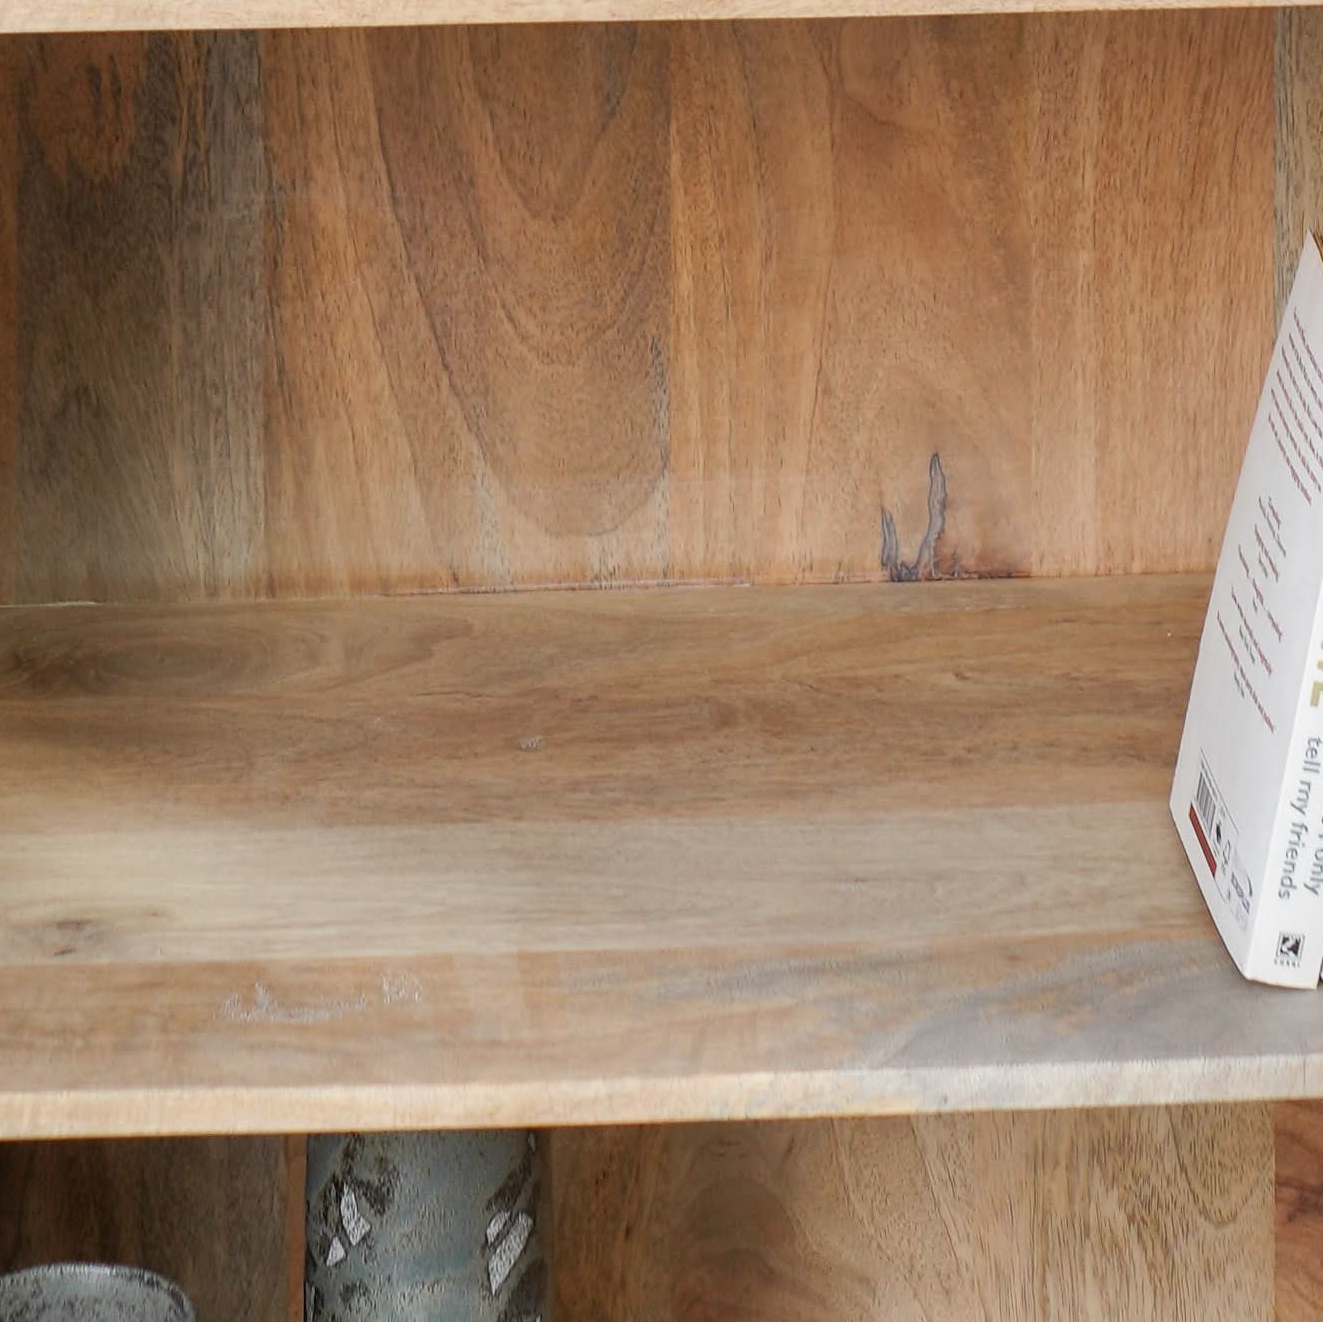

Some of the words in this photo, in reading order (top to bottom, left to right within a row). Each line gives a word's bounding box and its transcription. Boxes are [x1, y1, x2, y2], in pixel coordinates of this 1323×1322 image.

[1302, 737, 1322, 774] tell
[1290, 779, 1312, 816] my
[1278, 822, 1310, 901] friends
